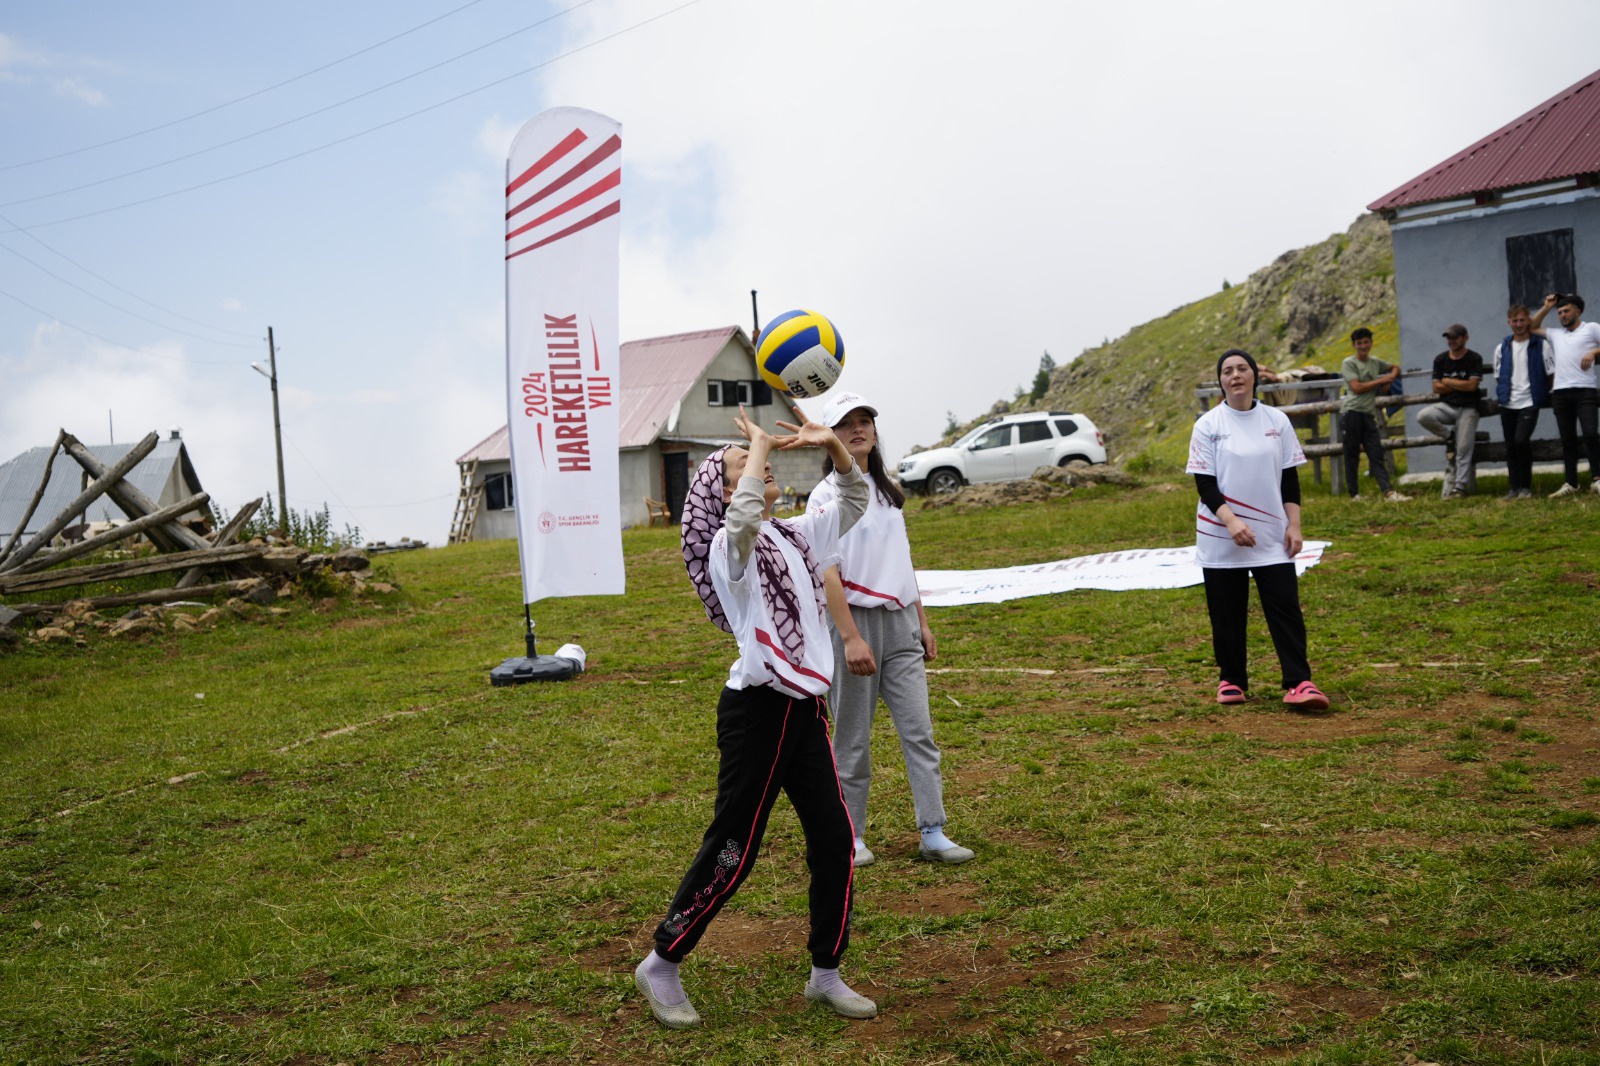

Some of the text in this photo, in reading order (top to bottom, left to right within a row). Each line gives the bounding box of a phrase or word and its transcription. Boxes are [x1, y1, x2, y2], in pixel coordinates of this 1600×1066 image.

[522, 372, 549, 417] 2024
[544, 313, 591, 472] HAREKETLİLİK
[586, 376, 612, 410] YILI
